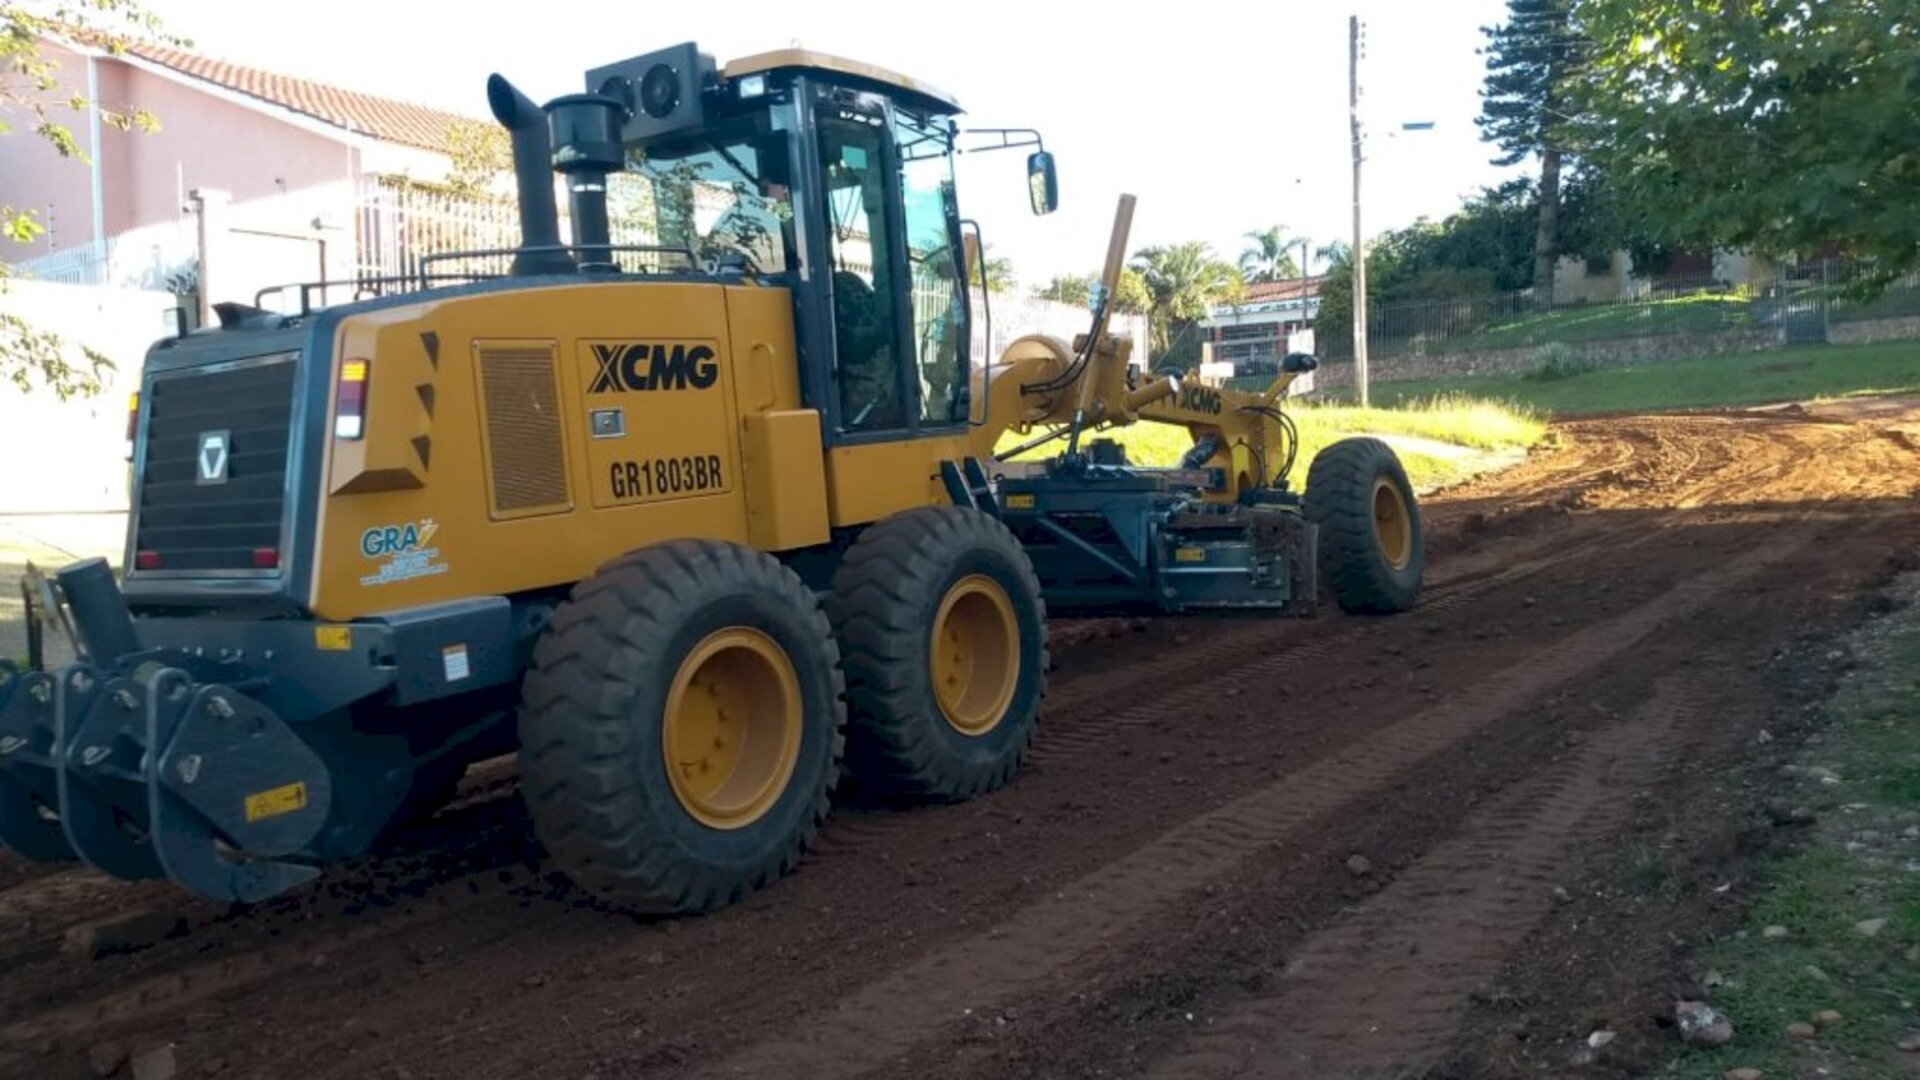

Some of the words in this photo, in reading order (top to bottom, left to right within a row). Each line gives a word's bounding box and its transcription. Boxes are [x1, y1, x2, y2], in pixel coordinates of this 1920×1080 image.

[587, 344, 718, 393] XCMG
[1182, 387, 1222, 415] XCMG
[610, 455, 723, 499] GR1803BR
